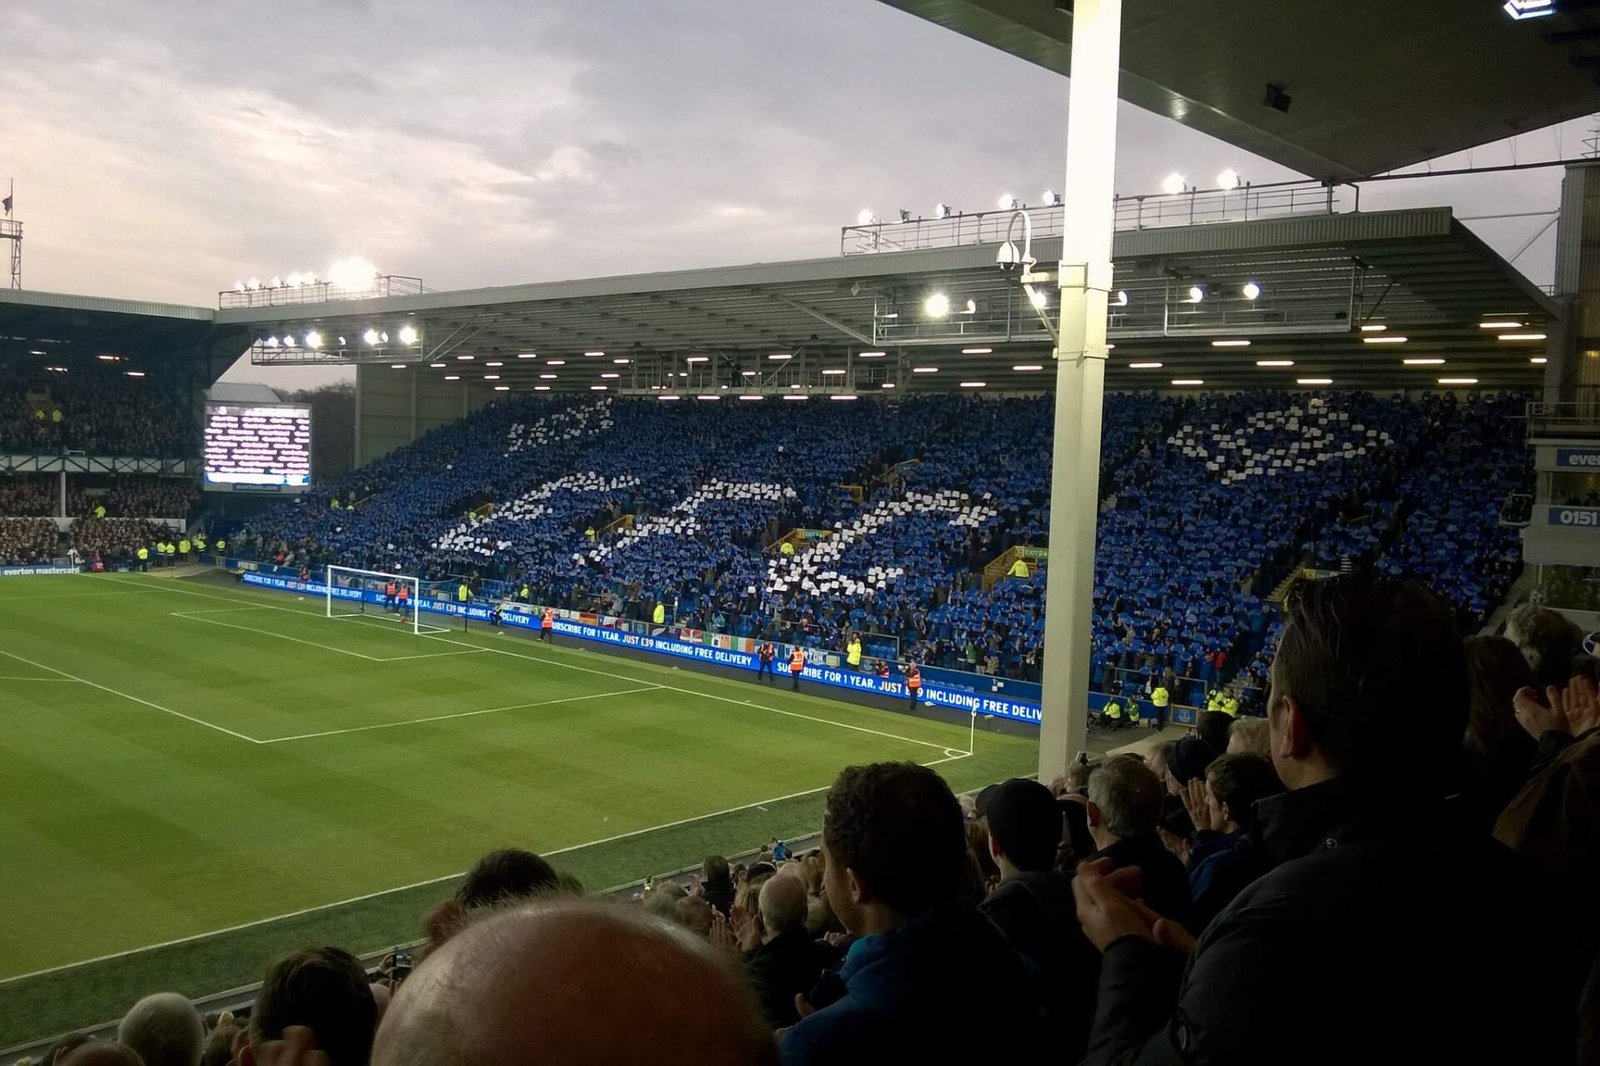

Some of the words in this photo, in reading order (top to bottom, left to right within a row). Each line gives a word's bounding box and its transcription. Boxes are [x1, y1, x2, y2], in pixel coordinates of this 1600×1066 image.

[1560, 510, 1597, 526] 0151
[4, 568, 34, 576] everton
[36, 567, 80, 575] mastercard
[551, 621, 582, 635] UBSCRIBE
[583, 626, 596, 637] FOR
[602, 631, 621, 642] YEAR.
[622, 634, 639, 645] JUST
[641, 637, 654, 647] £39
[655, 640, 693, 655] INCLUDING
[695, 646, 713, 659] FREE
[715, 651, 752, 666] DELIVERY
[824, 670, 842, 683] FOR
[843, 674, 848, 685] 1
[879, 681, 902, 694] JUST
[905, 684, 924, 698] £9
[926, 688, 980, 709] INCLUDING
[983, 699, 1009, 715] FREE
[1012, 704, 1042, 721] DELIV
